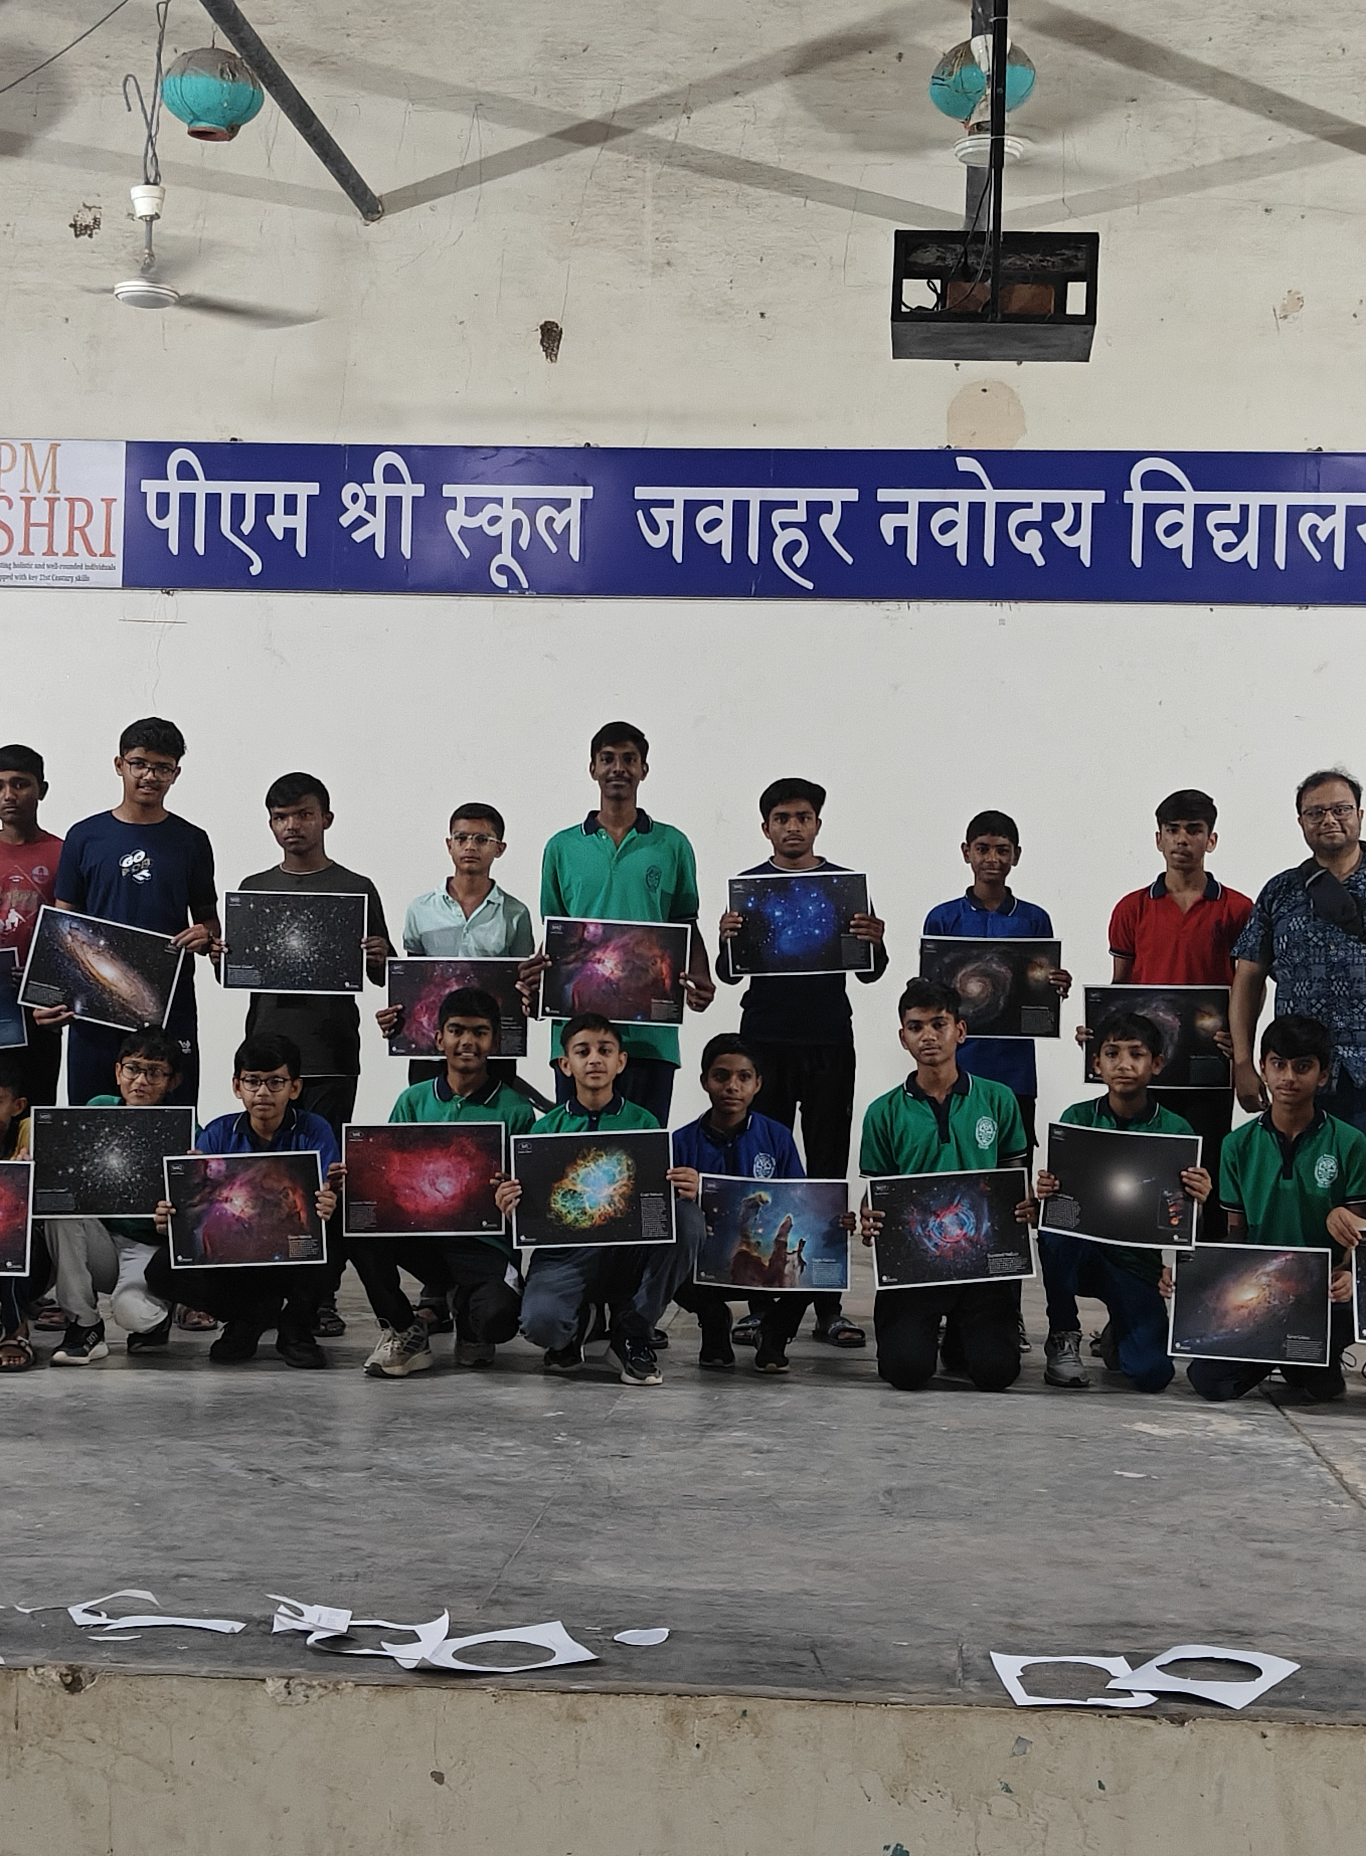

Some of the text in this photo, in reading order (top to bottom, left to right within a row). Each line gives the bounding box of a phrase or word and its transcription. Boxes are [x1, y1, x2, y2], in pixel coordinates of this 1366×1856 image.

[140, 448, 319, 576] पीएम
[339, 450, 425, 560] श्री
[442, 483, 594, 589] स्कूल
[634, 487, 859, 590] जवाहर
[877, 456, 1105, 567] नवोदय
